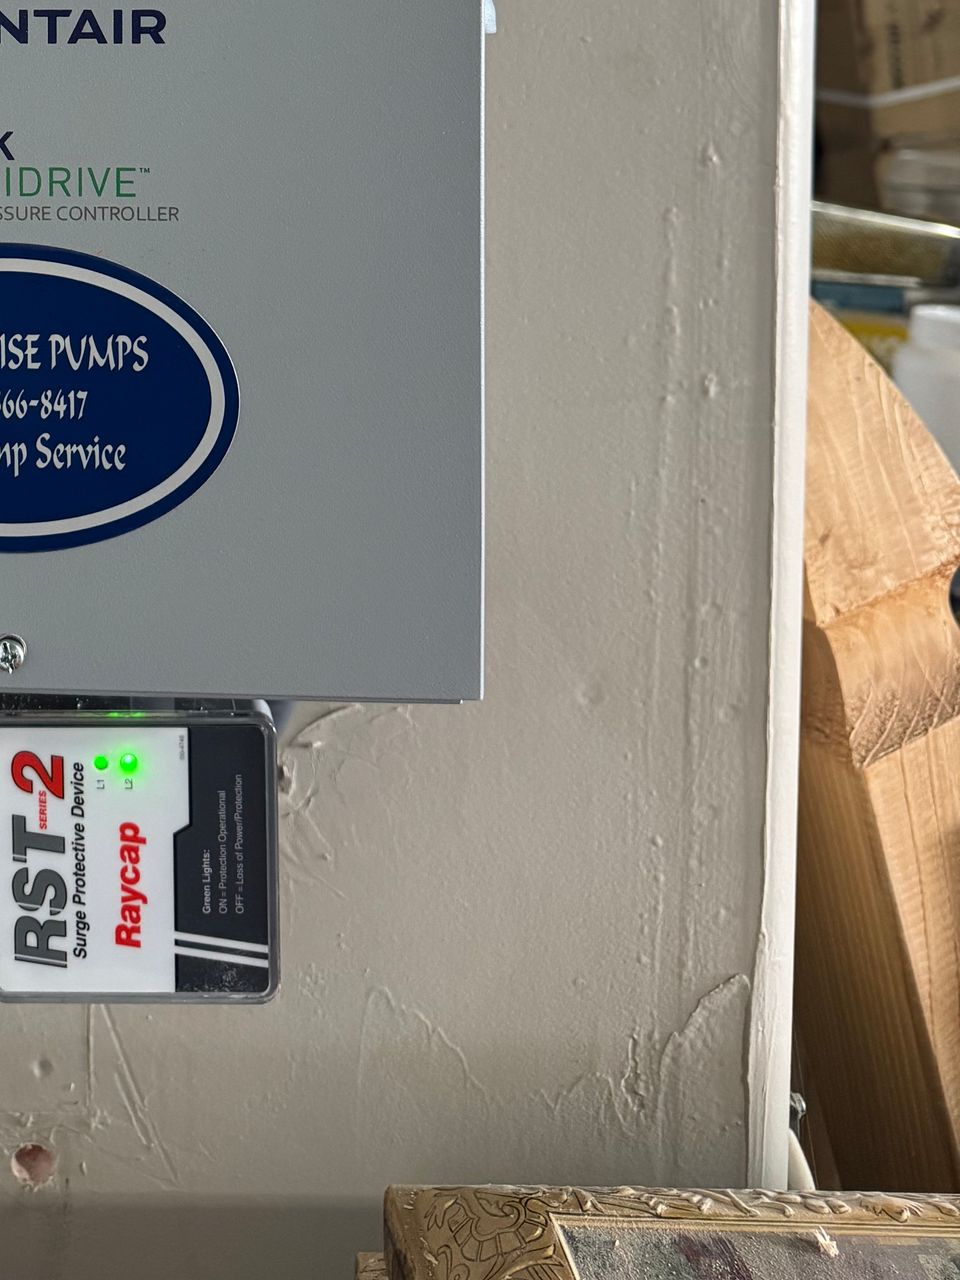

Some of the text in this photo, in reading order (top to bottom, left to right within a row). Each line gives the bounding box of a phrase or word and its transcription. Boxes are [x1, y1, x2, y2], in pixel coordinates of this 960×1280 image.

[56, 206, 180, 222] CONTROLLER
[48, 334, 149, 372] PUMPS
[35, 433, 127, 471] Service
[96, 779, 105, 790] L1
[124, 778, 133, 790] L2
[217, 791, 228, 842] Operational
[233, 774, 244, 849] Power/Protection
[11, 750, 68, 968] RST SERIES 2
[70, 762, 90, 959] Surge Protective Device
[218, 845, 227, 889] Protection
[234, 852, 243, 861] of
[235, 863, 244, 884] Loss
[115, 822, 148, 948] Raycap
[202, 849, 212, 914] Green Lights:
[218, 899, 228, 914] ON
[235, 894, 244, 914] OFF
